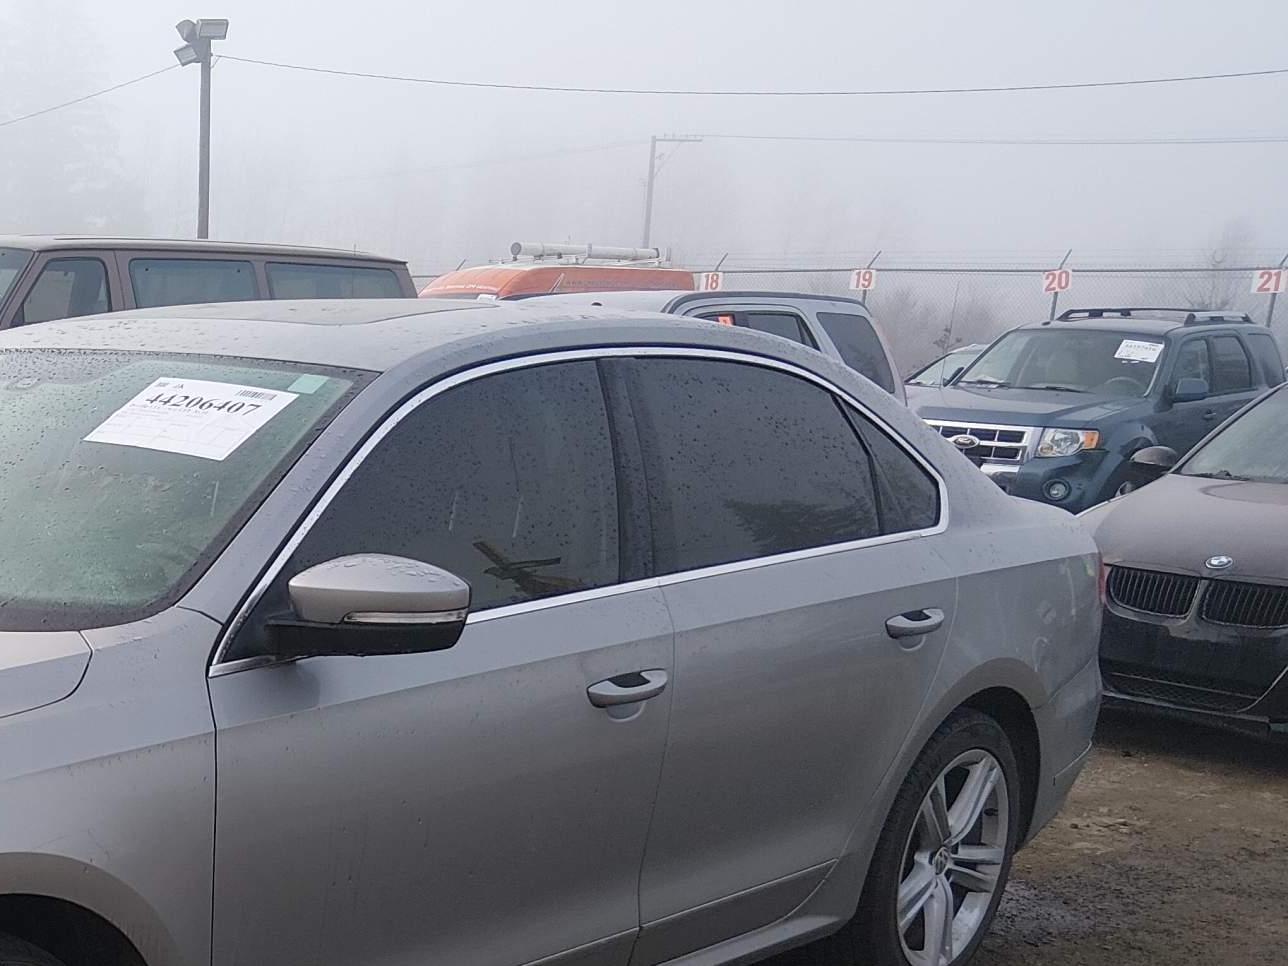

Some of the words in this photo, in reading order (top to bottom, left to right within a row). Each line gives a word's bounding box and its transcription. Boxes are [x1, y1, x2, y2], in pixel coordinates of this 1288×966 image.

[703, 273, 720, 291] 18
[854, 270, 873, 289] 19
[1044, 270, 1070, 292] 20
[1256, 270, 1282, 293] 21
[146, 393, 264, 416] 44206407
